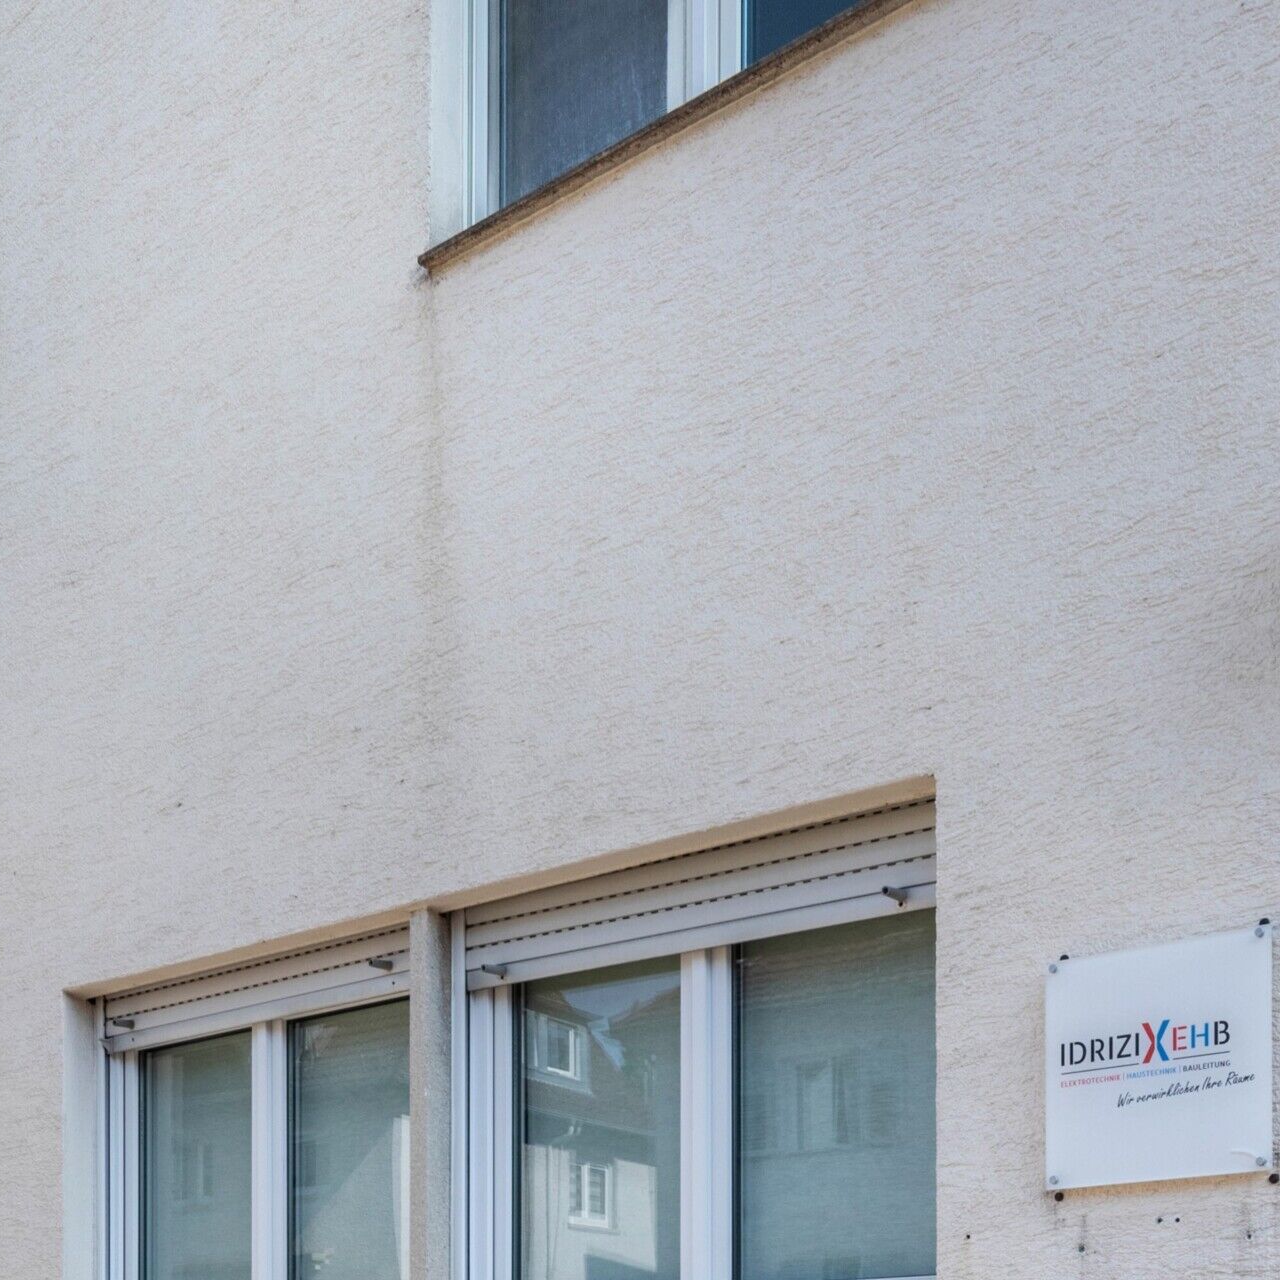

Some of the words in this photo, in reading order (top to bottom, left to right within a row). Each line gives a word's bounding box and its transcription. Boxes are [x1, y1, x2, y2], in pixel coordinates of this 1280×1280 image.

[1060, 1074, 1121, 1089] ELEKTROTECHNIK
[1126, 1067, 1177, 1080] HAUSTECHNIK
[1182, 1060, 1231, 1073] BAULEITUNG
[1117, 1093, 1134, 1108] Wir
[1136, 1082, 1199, 1104] verwirklichen
[1202, 1076, 1222, 1091] Ihre
[1225, 1071, 1255, 1087] Räume
